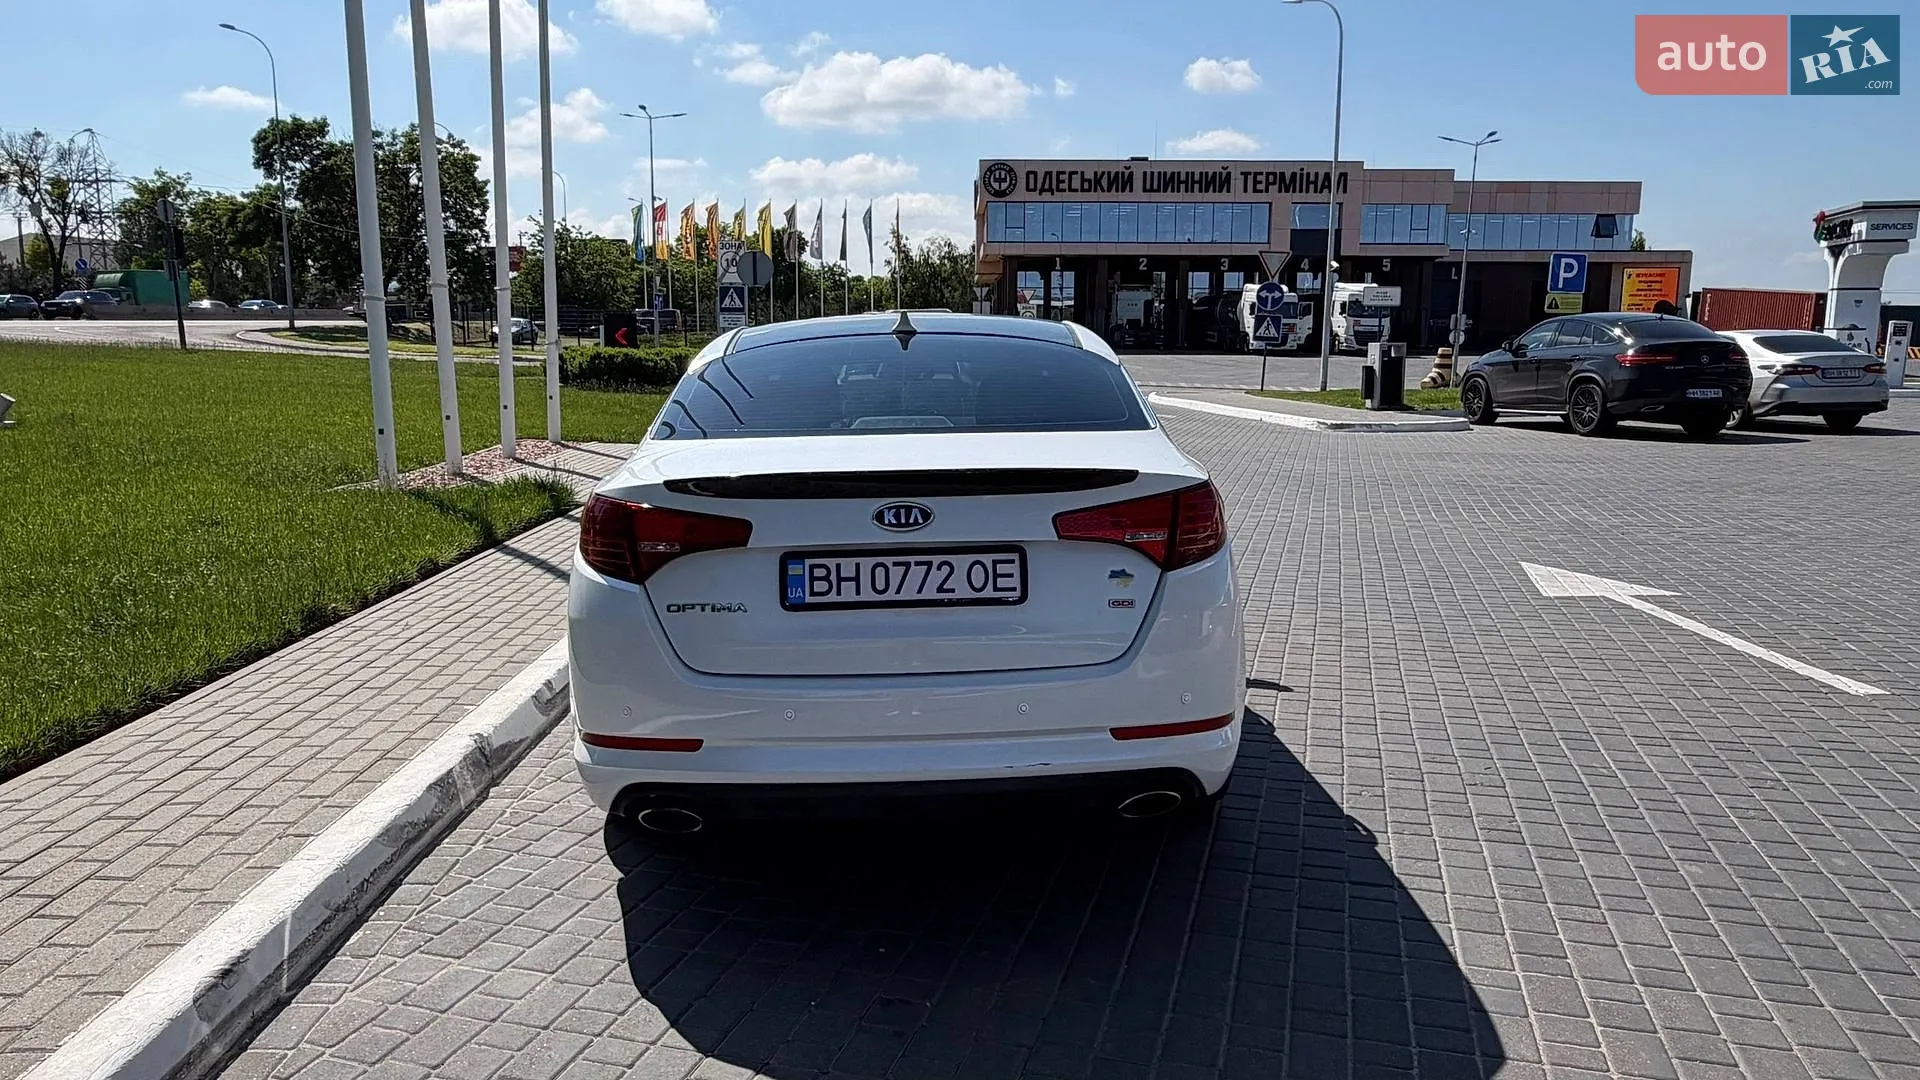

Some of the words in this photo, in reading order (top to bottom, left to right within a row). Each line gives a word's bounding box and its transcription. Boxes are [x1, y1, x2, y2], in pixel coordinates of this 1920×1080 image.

[1025, 165, 1134, 196] ОДЕСЬКИЙ
[1142, 165, 1231, 193] ШИННИЙ
[1870, 222, 1914, 231] SERVICES
[724, 258, 738, 268] 10
[1055, 257, 1061, 270] 1
[1138, 257, 1148, 271] 2
[1220, 257, 1229, 271] 3
[1300, 258, 1309, 271] 4
[1382, 258, 1391, 271] 5
[1557, 257, 1579, 289] P
[883, 508, 923, 524] KIA
[808, 562, 861, 598] BH
[870, 560, 956, 596] 0772
[966, 558, 1018, 594] OE
[787, 586, 804, 599] UA
[666, 602, 748, 613] OPTIMA
